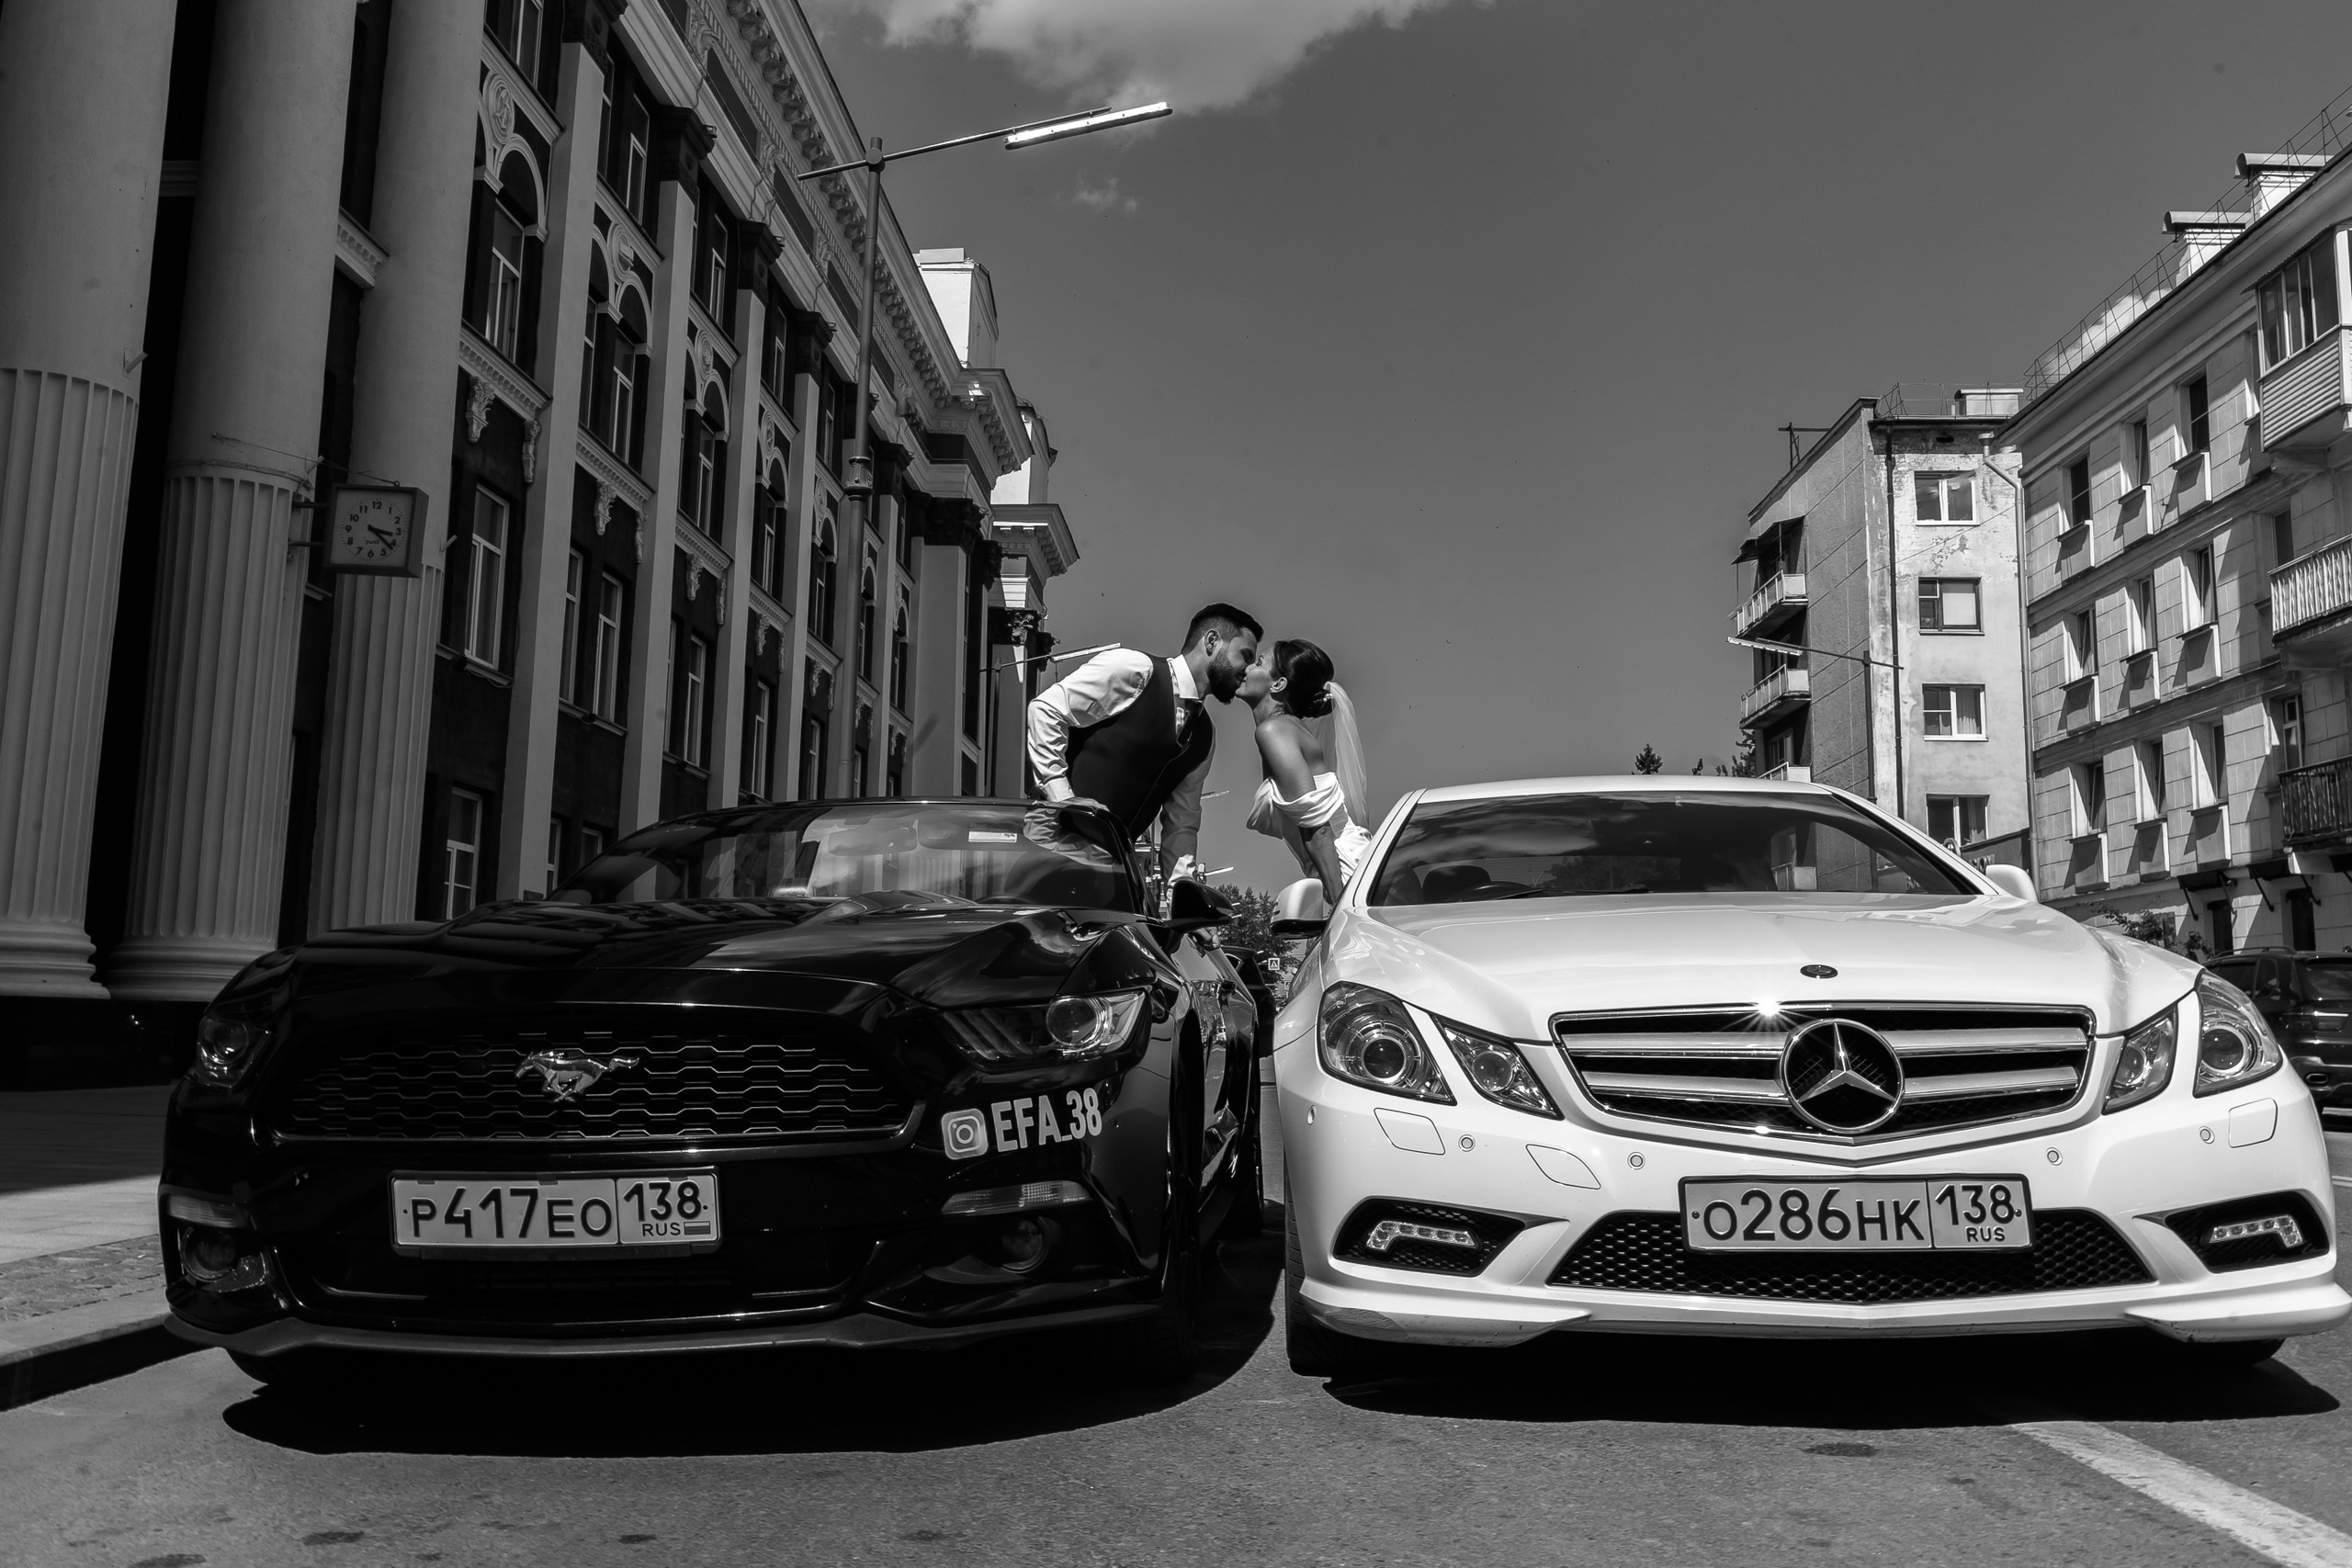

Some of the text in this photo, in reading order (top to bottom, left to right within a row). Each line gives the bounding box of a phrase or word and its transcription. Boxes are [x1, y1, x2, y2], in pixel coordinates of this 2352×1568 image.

[359, 505, 368, 513] 11
[372, 502, 382, 510] 12
[388, 506, 392, 514] 1
[393, 516, 401, 525] 2
[345, 525, 352, 533] 9
[395, 527, 401, 536] 3
[347, 536, 354, 546] 8
[356, 547, 363, 555] 7
[368, 549, 374, 558] 6
[622, 1180, 702, 1222] 138
[1934, 1184, 2015, 1226] 138
[643, 1223, 681, 1237] RUS
[1964, 1226, 2007, 1243] RUS
